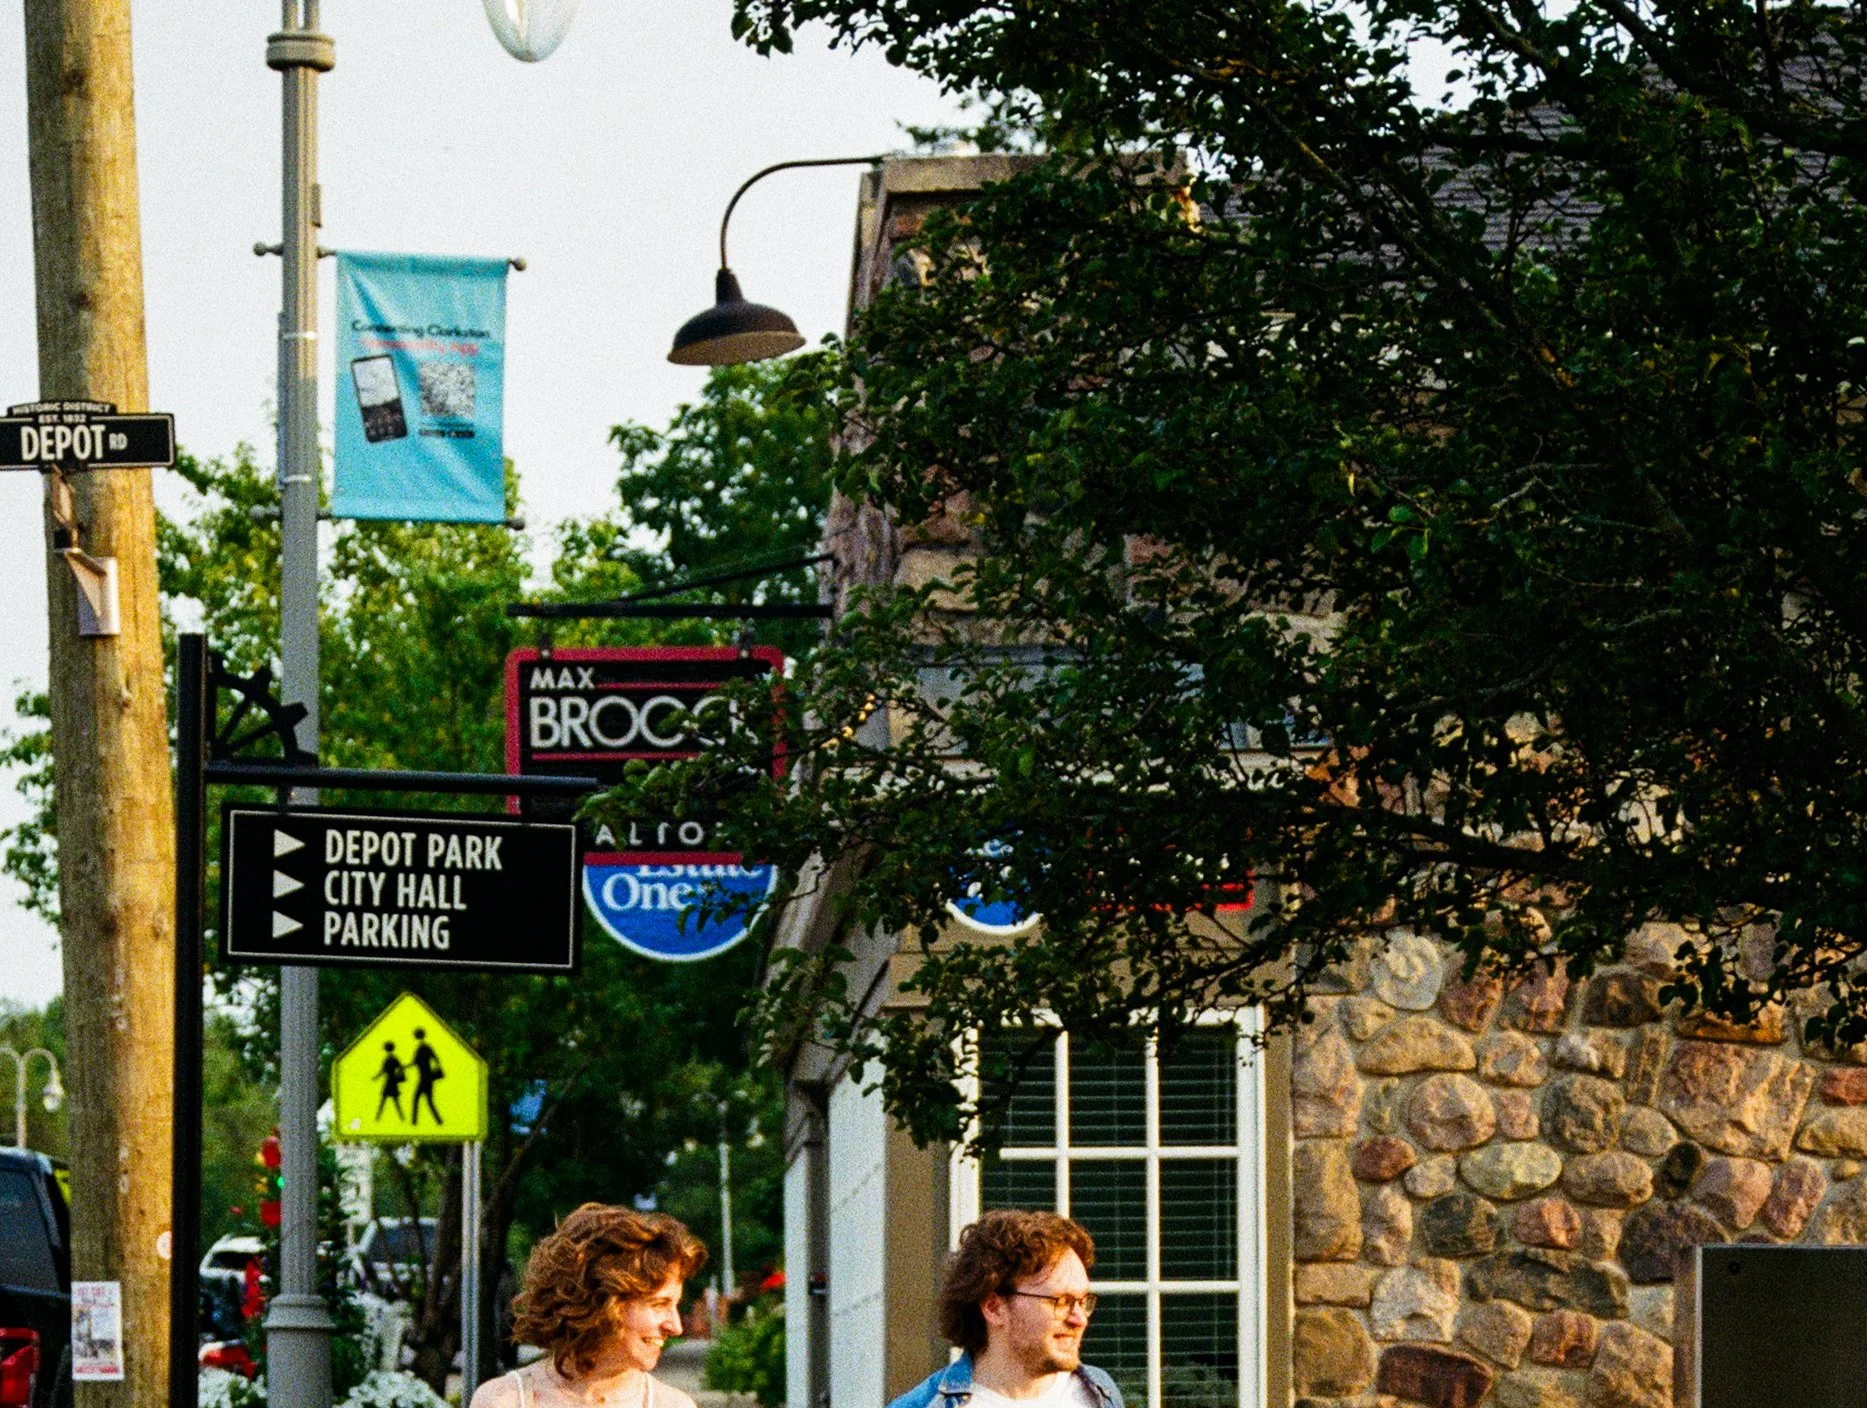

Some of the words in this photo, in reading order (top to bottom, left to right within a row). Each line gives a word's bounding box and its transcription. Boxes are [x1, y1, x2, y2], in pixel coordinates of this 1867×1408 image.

[12, 402, 61, 415] HISTORIC
[63, 402, 111, 414] DISTRICT
[20, 424, 106, 461] DEPOT
[108, 432, 128, 450] RD
[529, 667, 595, 689] MAX
[325, 829, 417, 867] DEPOT
[427, 833, 503, 871] PARK
[324, 870, 386, 907] CITY
[397, 873, 467, 910] HALL
[323, 911, 450, 949] PARKING
